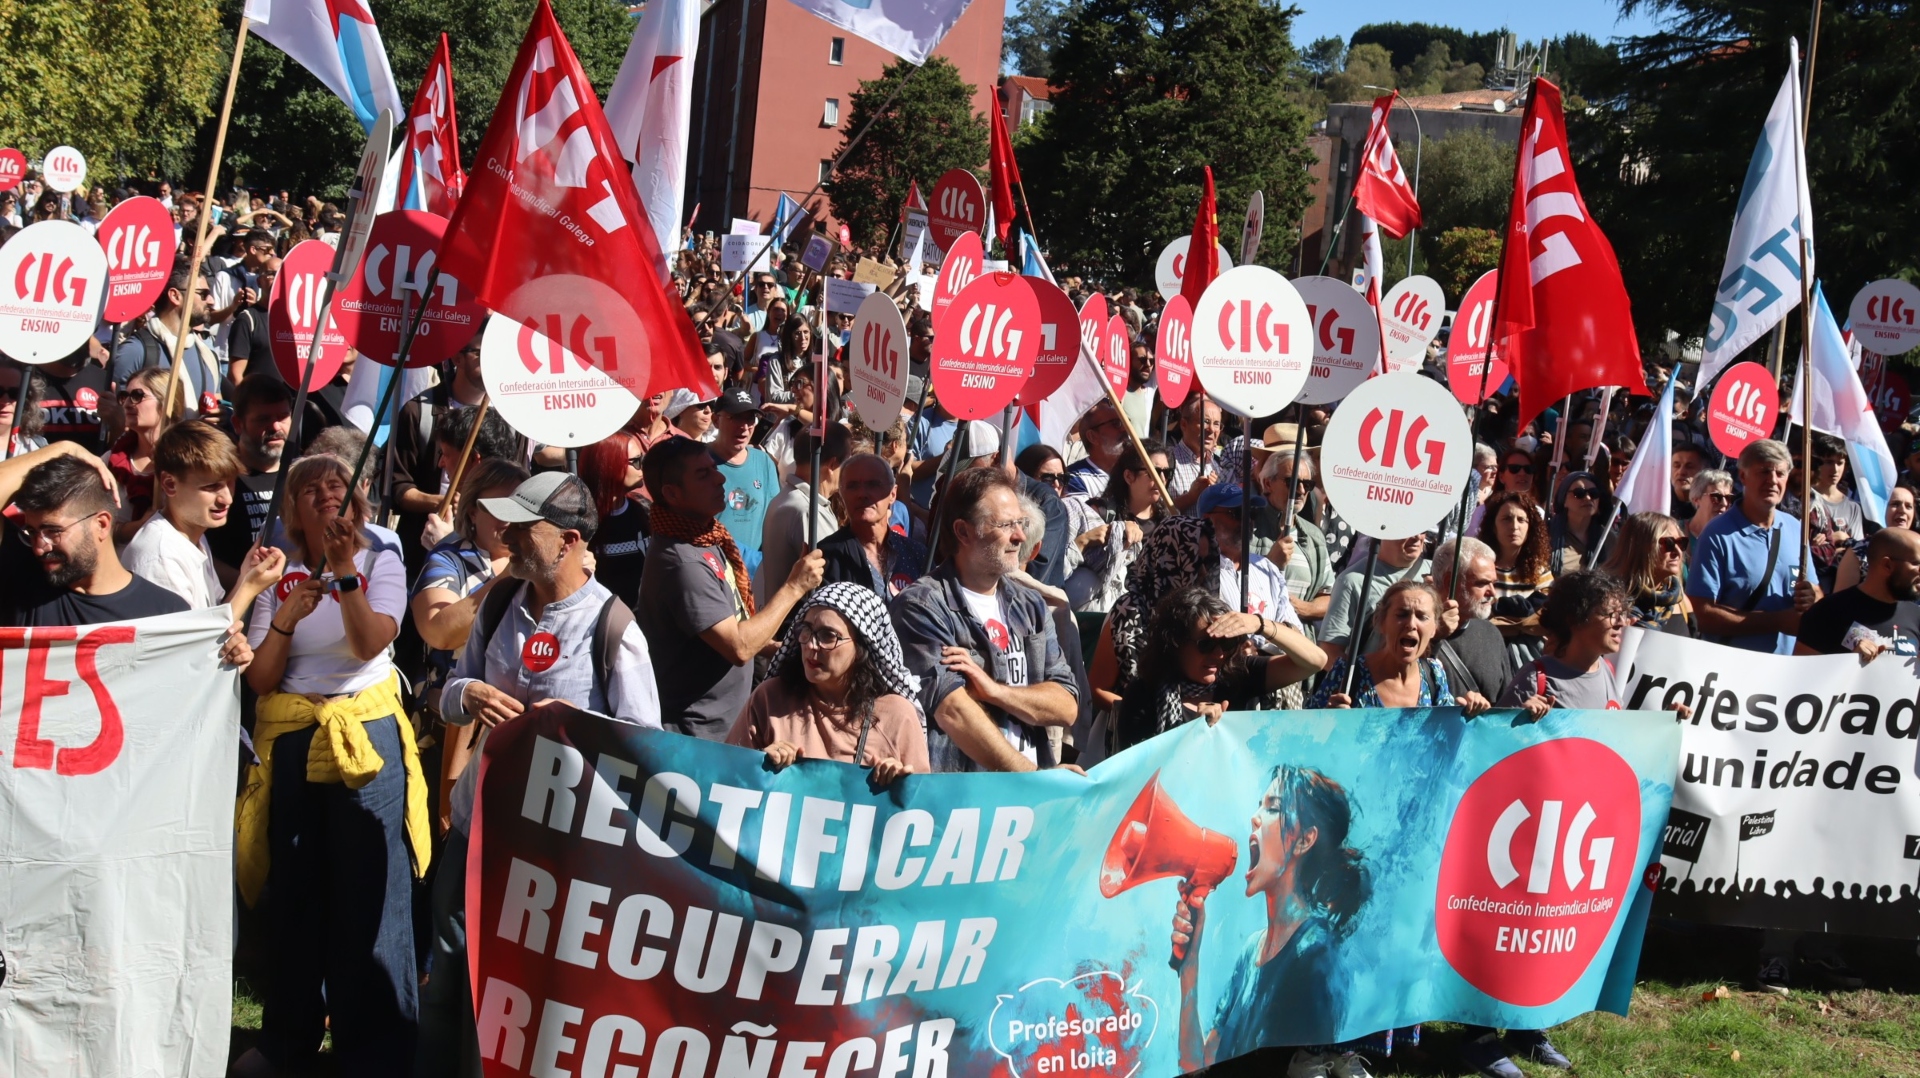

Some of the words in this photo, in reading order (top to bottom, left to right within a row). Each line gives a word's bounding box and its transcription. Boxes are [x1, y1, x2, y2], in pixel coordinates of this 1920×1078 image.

[0, 157, 19, 175] IG
[53, 156, 78, 173] CIG
[941, 186, 975, 222] CIG
[559, 215, 595, 247] Galega
[107, 224, 160, 270] CIG
[14, 251, 87, 307] CIG
[124, 271, 150, 280] Intersindical
[150, 270, 164, 279] Galega
[365, 243, 458, 306] CIG
[948, 255, 975, 295] CIG
[113, 282, 142, 297] ENSINO
[36, 306, 72, 319] Intersindical
[72, 311, 93, 323] Galega
[341, 298, 395, 313] Confederación
[397, 304, 443, 319] Inersdical
[445, 310, 471, 323] Galega
[1394, 291, 1432, 332] CIG
[1866, 295, 1915, 325] CIG
[21, 318, 60, 334] ENSINO
[379, 317, 430, 336] ENSIO
[960, 303, 1023, 361] CIG
[1218, 299, 1289, 354] CIG
[1467, 300, 1494, 348] CI
[1874, 330, 1900, 340] ENSINO
[330, 334, 344, 343] Galega
[517, 313, 618, 375] CIG
[1166, 317, 1190, 364] CIG
[1389, 329, 1410, 344] ENSINO
[297, 345, 324, 359] ENSO
[863, 321, 898, 380] CIG
[1046, 354, 1068, 363] Galega
[1111, 333, 1126, 368] CIG
[1453, 351, 1479, 362] Confederación
[939, 357, 975, 369] Confederación
[975, 361, 1006, 373] Intersindical
[1006, 365, 1024, 376] Galega
[1202, 355, 1244, 366] Confederación
[1245, 356, 1281, 367] Intersindical
[1281, 358, 1301, 370] Galega
[1310, 365, 1330, 379] INO
[1312, 356, 1341, 367] ersindical
[1342, 358, 1364, 370] Galega
[1388, 363, 1401, 372] SINO
[1468, 361, 1493, 377] ENSIO
[499, 380, 557, 393] Confederación
[558, 377, 607, 390] Intersindical
[608, 375, 636, 387] Galega
[961, 373, 996, 390] ENSINO
[1233, 370, 1272, 385] ENSINO
[543, 392, 597, 411] ENSINO
[867, 385, 886, 404] ENSINO
[1726, 380, 1767, 425] CIG
[1358, 406, 1446, 476] CIG
[1725, 424, 1748, 440] ENSINO
[1333, 464, 1383, 482] Confederación
[1384, 472, 1428, 489] Intersindical
[1428, 480, 1453, 494] Galega
[1366, 484, 1414, 506] ENSINO
[532, 641, 554, 657] CIG
[1682, 749, 1901, 795] unidade
[521, 735, 1035, 892] RECTIFICAR
[1743, 814, 1775, 825] Palestina
[1664, 822, 1704, 847] arial
[1749, 825, 1767, 836] Libre
[1487, 798, 1615, 894] CIG
[1447, 894, 1532, 917] Confederación
[1534, 897, 1590, 918] Intersindical
[1590, 895, 1614, 914] Galega
[497, 857, 998, 1006] RECUPERAR
[1495, 926, 1577, 954] ENSINO
[1009, 1009, 1142, 1043] Profesorado
[1037, 1054, 1064, 1074] en
[1070, 1046, 1117, 1070] loita
